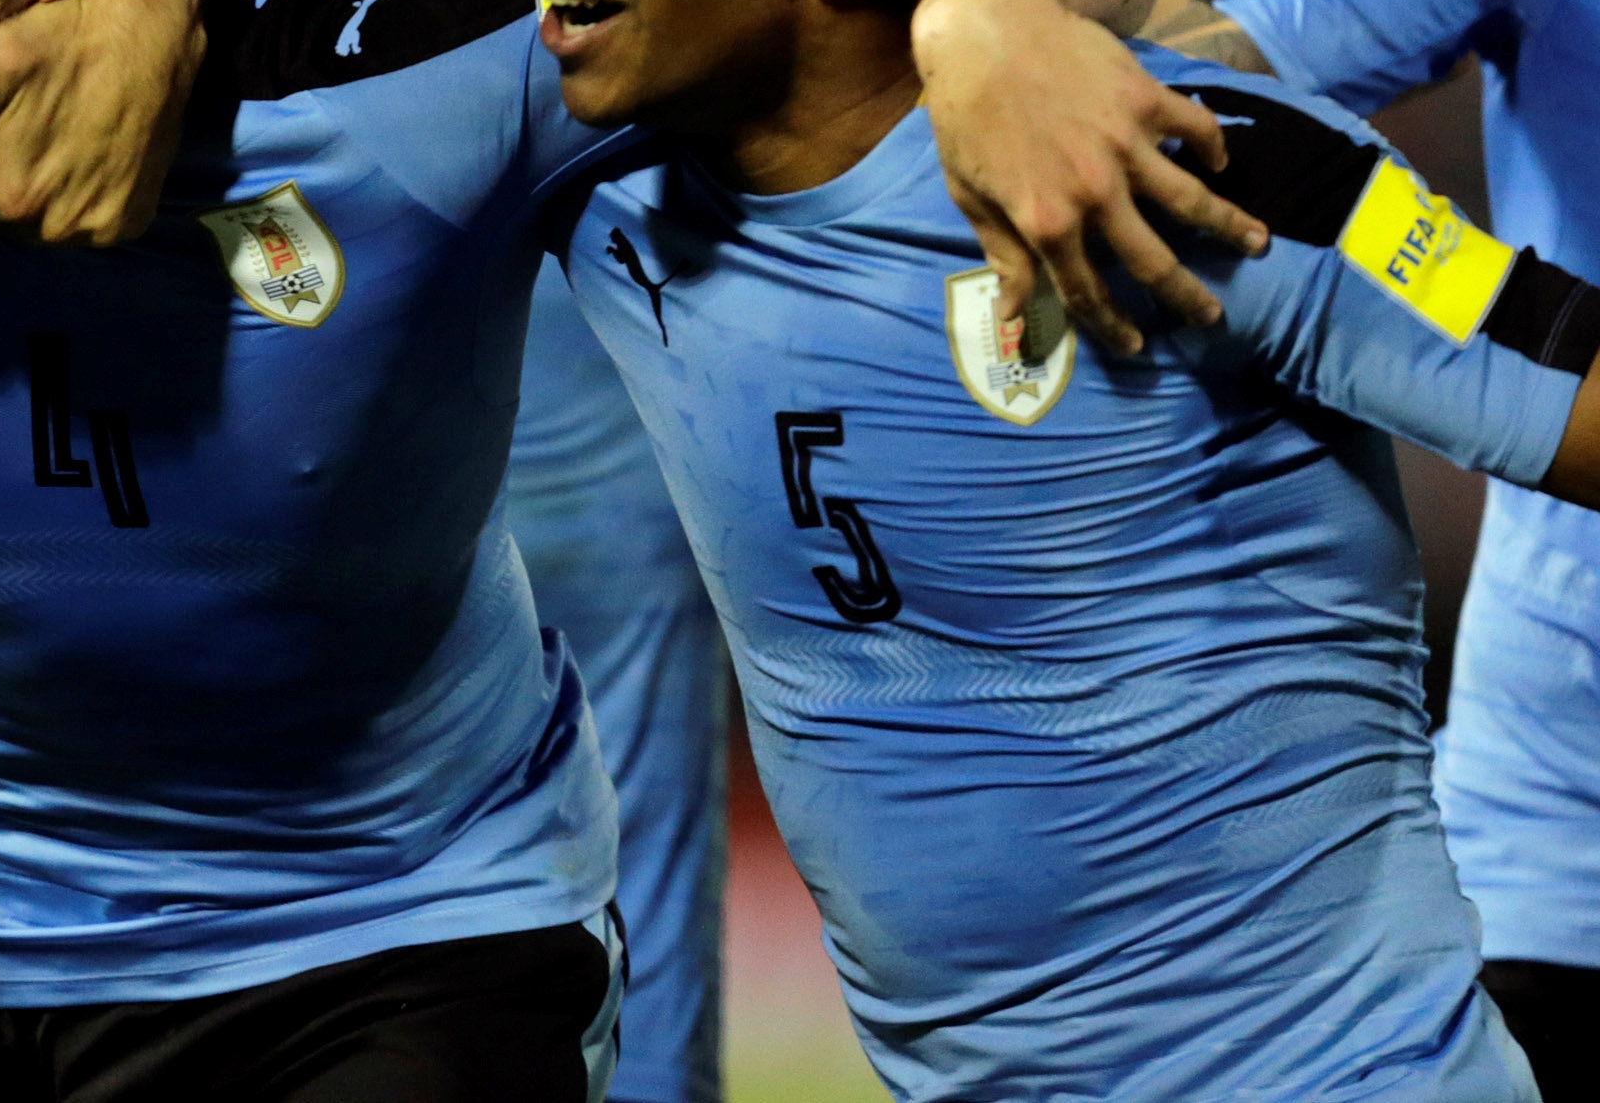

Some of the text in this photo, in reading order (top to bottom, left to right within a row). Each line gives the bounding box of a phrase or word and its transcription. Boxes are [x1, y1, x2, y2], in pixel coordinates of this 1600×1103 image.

[1386, 218, 1436, 285] FIFA
[27, 329, 150, 529] 4
[775, 411, 903, 624] 5
